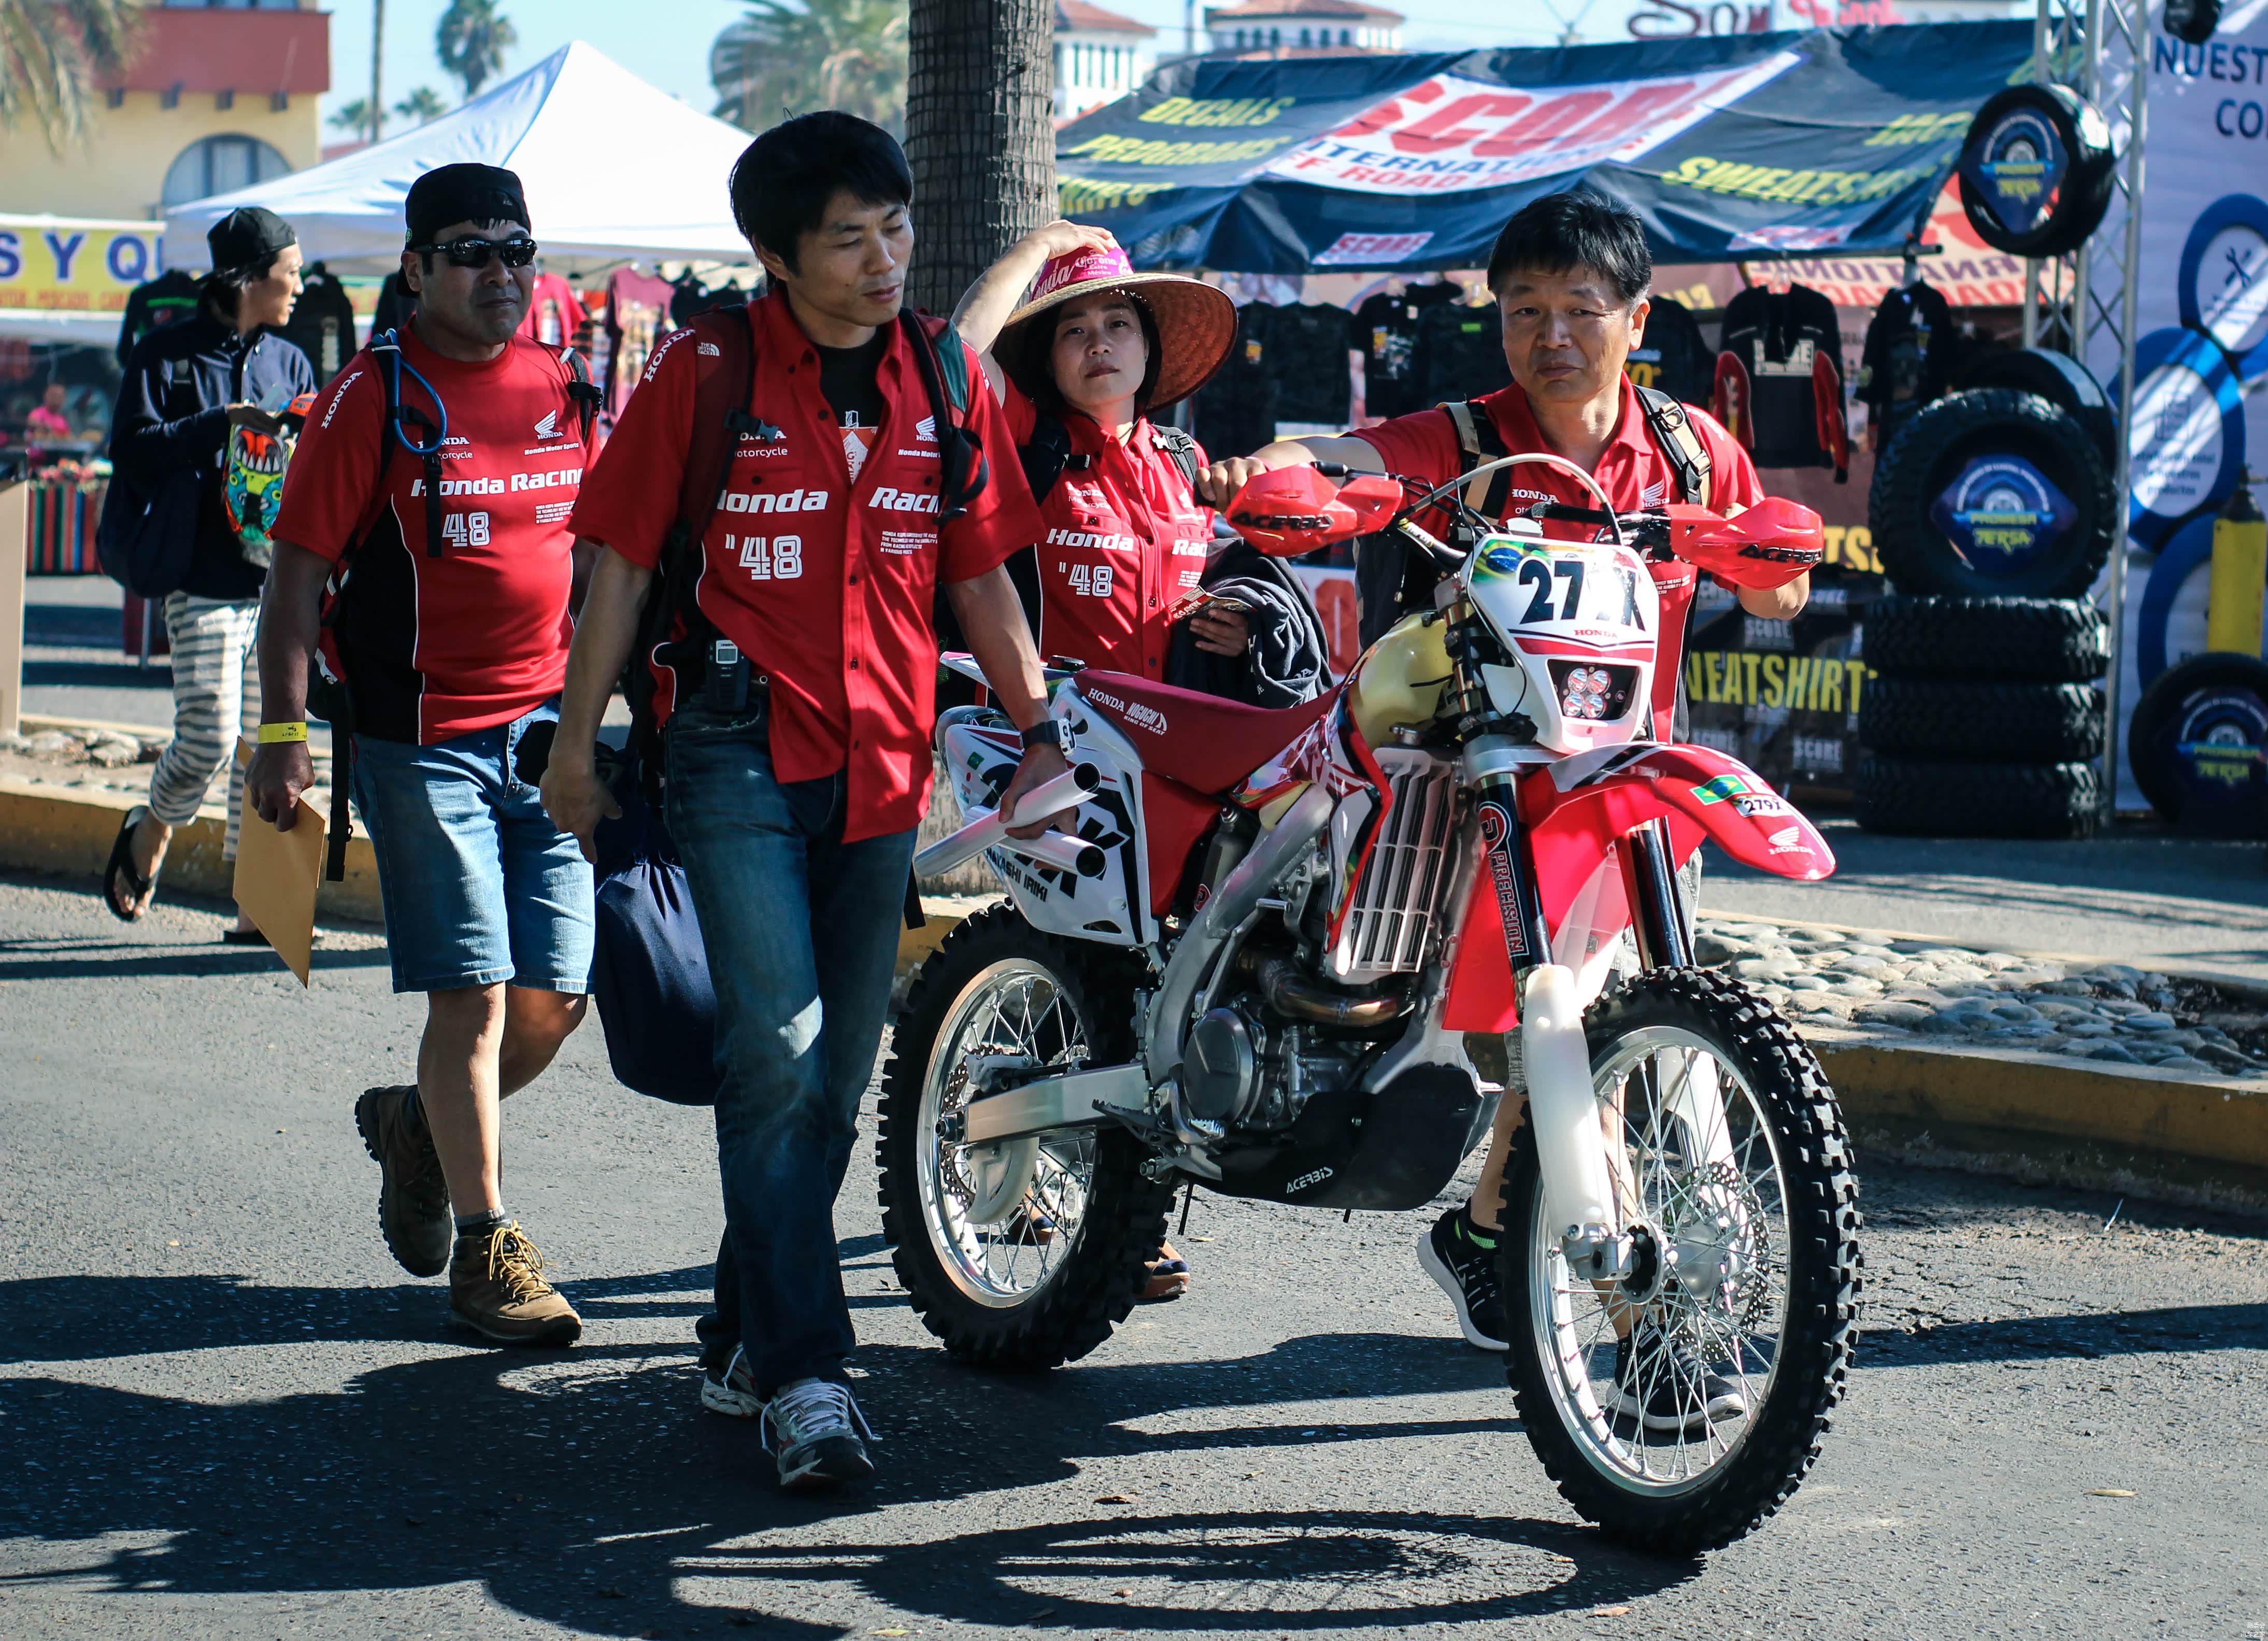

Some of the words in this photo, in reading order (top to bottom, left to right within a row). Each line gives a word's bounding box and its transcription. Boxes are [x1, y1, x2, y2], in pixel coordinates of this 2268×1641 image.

[2155, 36, 2268, 84] NUEST
[46, 234, 84, 280] Y
[1075, 255, 1117, 268] Corona
[644, 329, 695, 382] HONDA
[321, 371, 363, 429] HONDA
[537, 431, 564, 439] HONDA
[524, 447, 545, 455] Honda
[735, 447, 788, 457] otorcycle
[1046, 529, 1134, 551] Honda
[1519, 560, 1646, 631] 27X
[1575, 629, 1618, 638] HONDA
[1088, 688, 1125, 712] HONDA
[1126, 702, 1160, 724] NOGUCHI
[1123, 716, 1139, 724] KING
[1148, 726, 1166, 735] SEAT
[1744, 799, 1783, 812] 279X
[1768, 846, 1816, 855] HONDA
[1492, 851, 1524, 953] PRECISION
